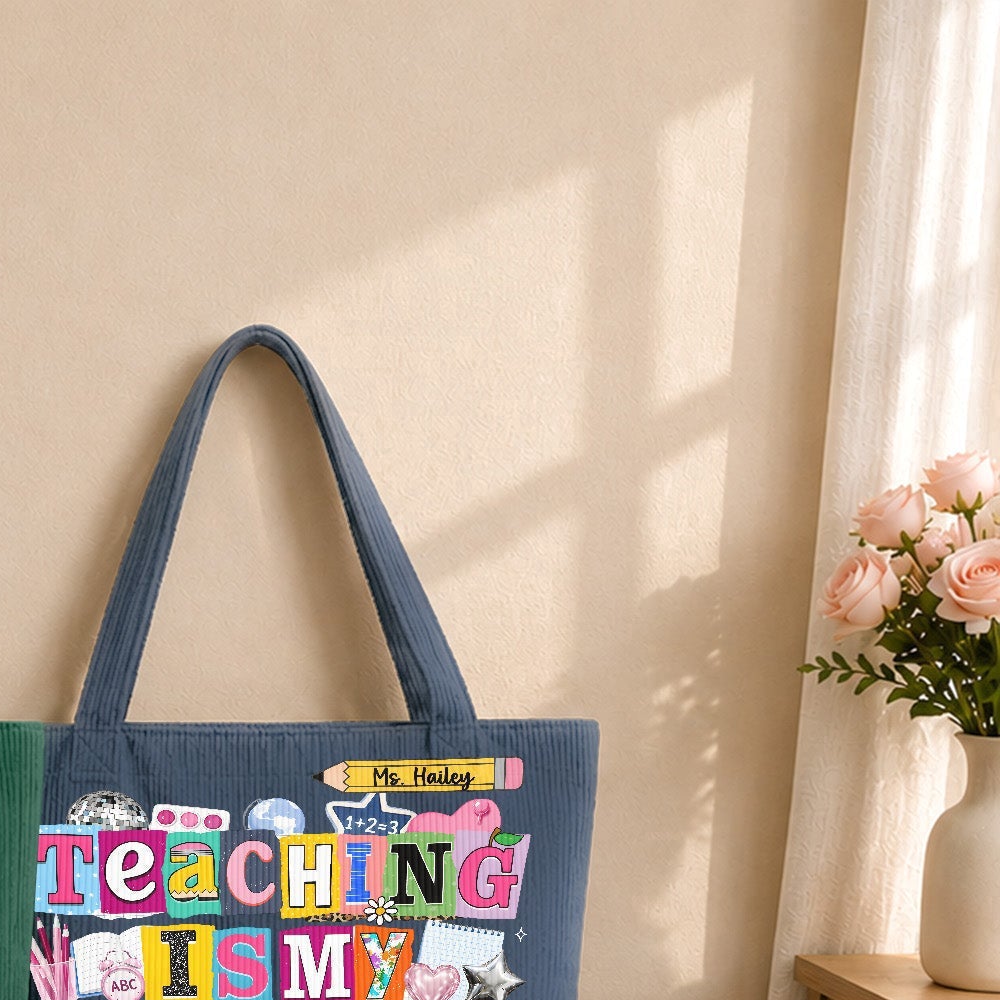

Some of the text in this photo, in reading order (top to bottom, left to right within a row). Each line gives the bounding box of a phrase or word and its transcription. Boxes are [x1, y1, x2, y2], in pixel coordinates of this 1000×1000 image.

[373, 767, 475, 791] Ms. Hailey
[345, 816, 399, 835] 1+2=3
[161, 929, 270, 1000] IS
[110, 978, 137, 992] ABC
